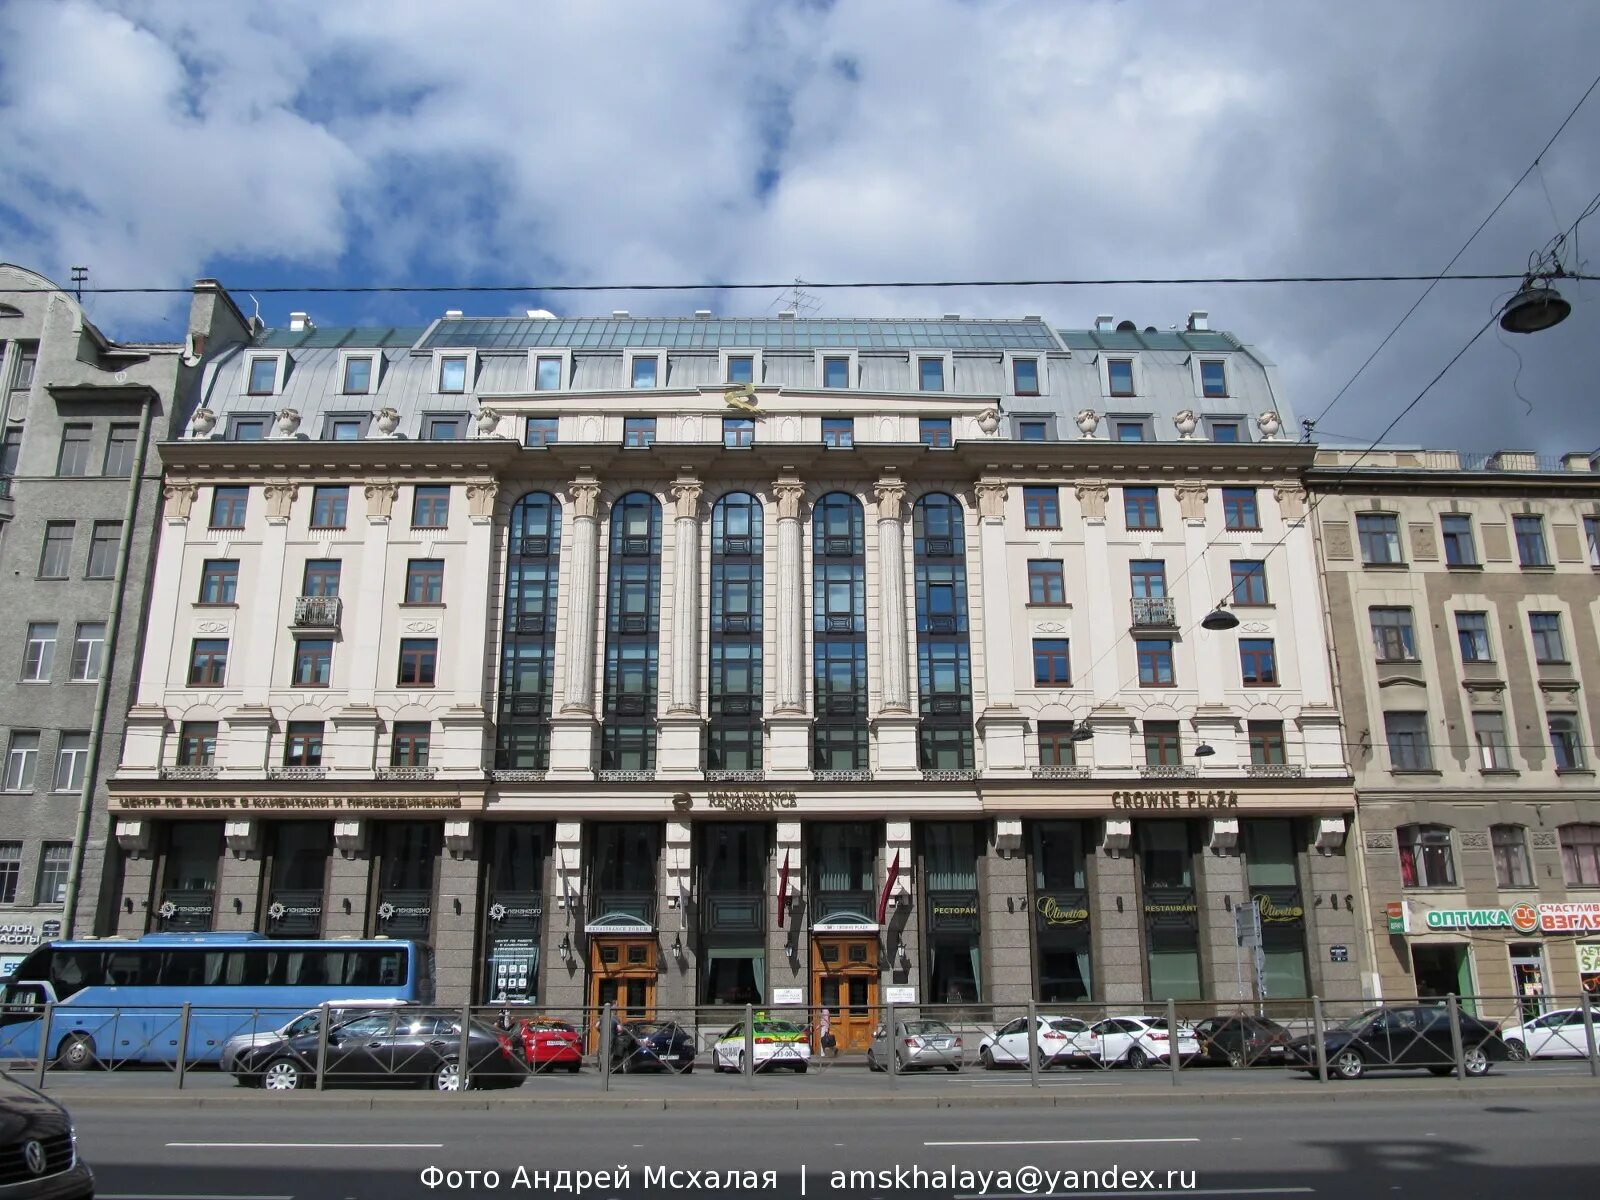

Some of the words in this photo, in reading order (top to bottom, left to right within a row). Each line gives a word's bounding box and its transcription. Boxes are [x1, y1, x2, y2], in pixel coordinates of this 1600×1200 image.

[1112, 790, 1181, 809] CROWNE
[1187, 790, 1238, 809] PLAZA
[933, 907, 977, 915] РЕСТОРАН
[1539, 904, 1600, 913] СЧАСТЛИВ
[1428, 909, 1511, 926] ОПТИКА
